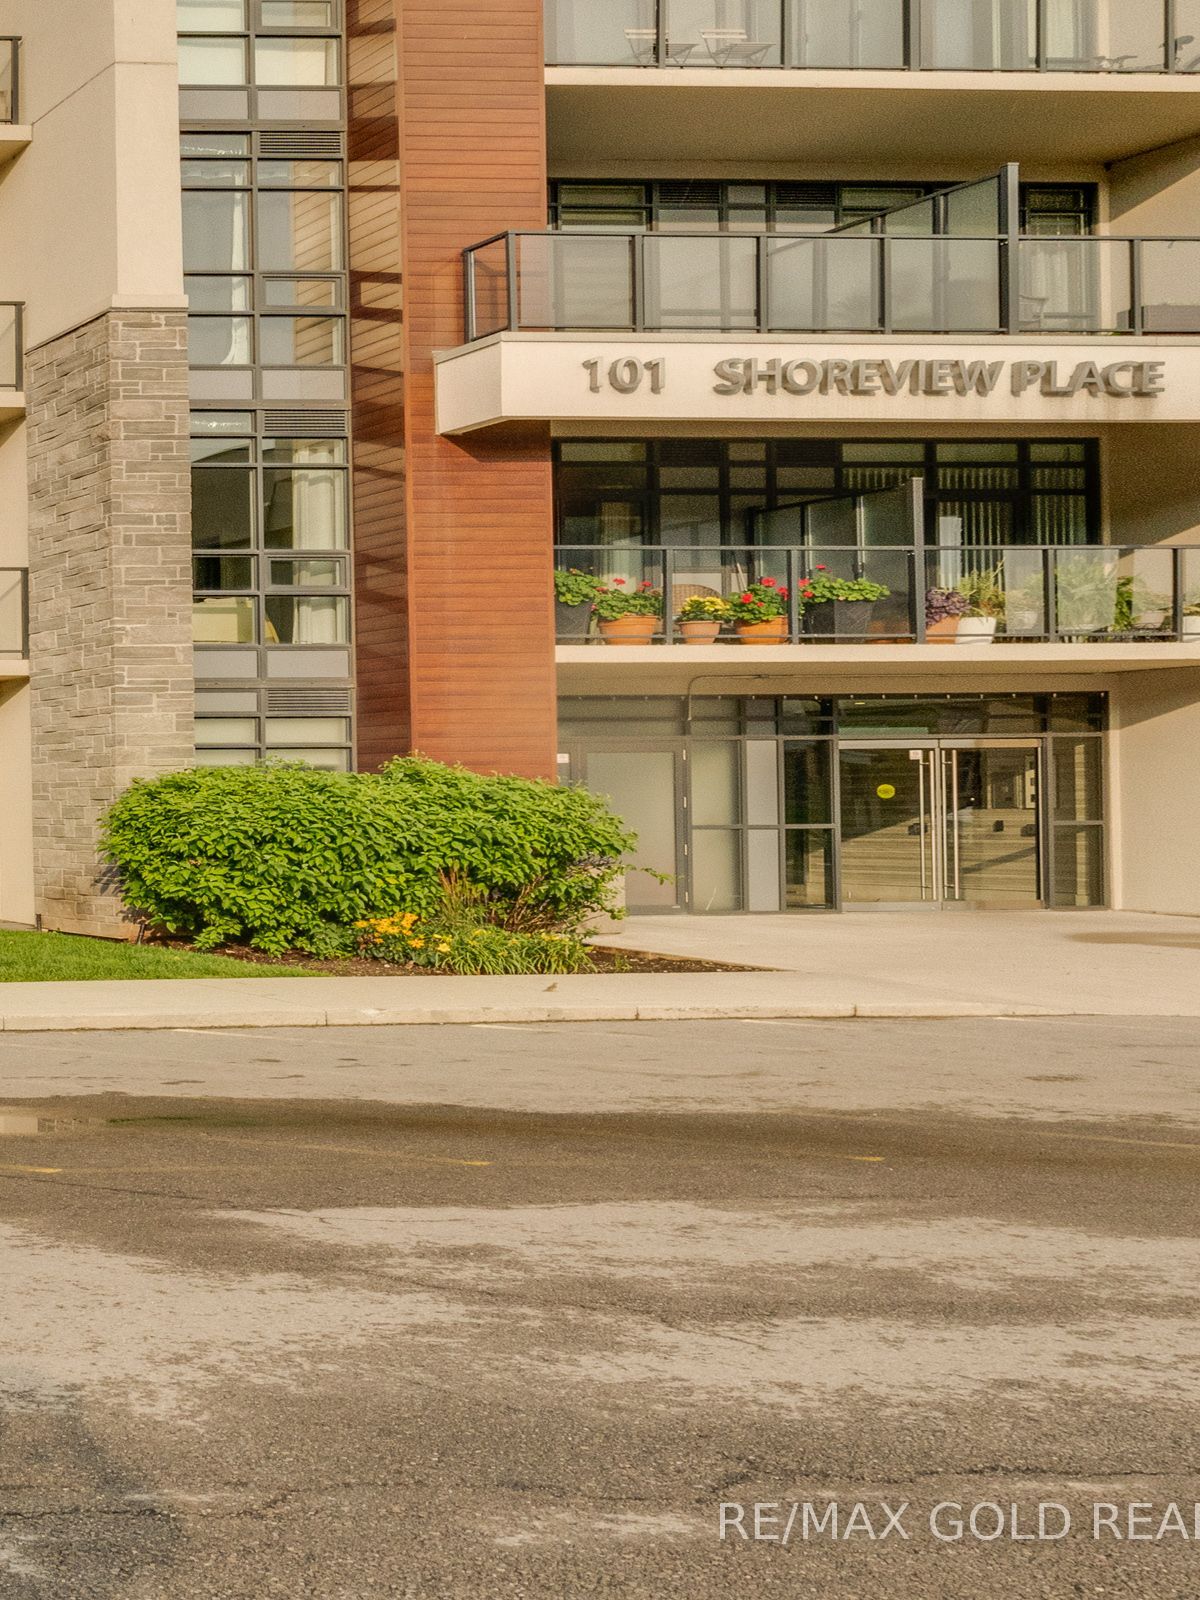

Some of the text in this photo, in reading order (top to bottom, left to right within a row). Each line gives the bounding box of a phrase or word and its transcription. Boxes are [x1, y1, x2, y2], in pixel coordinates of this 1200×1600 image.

[582, 355, 1166, 398] 101 SHOREVIEW PLACE
